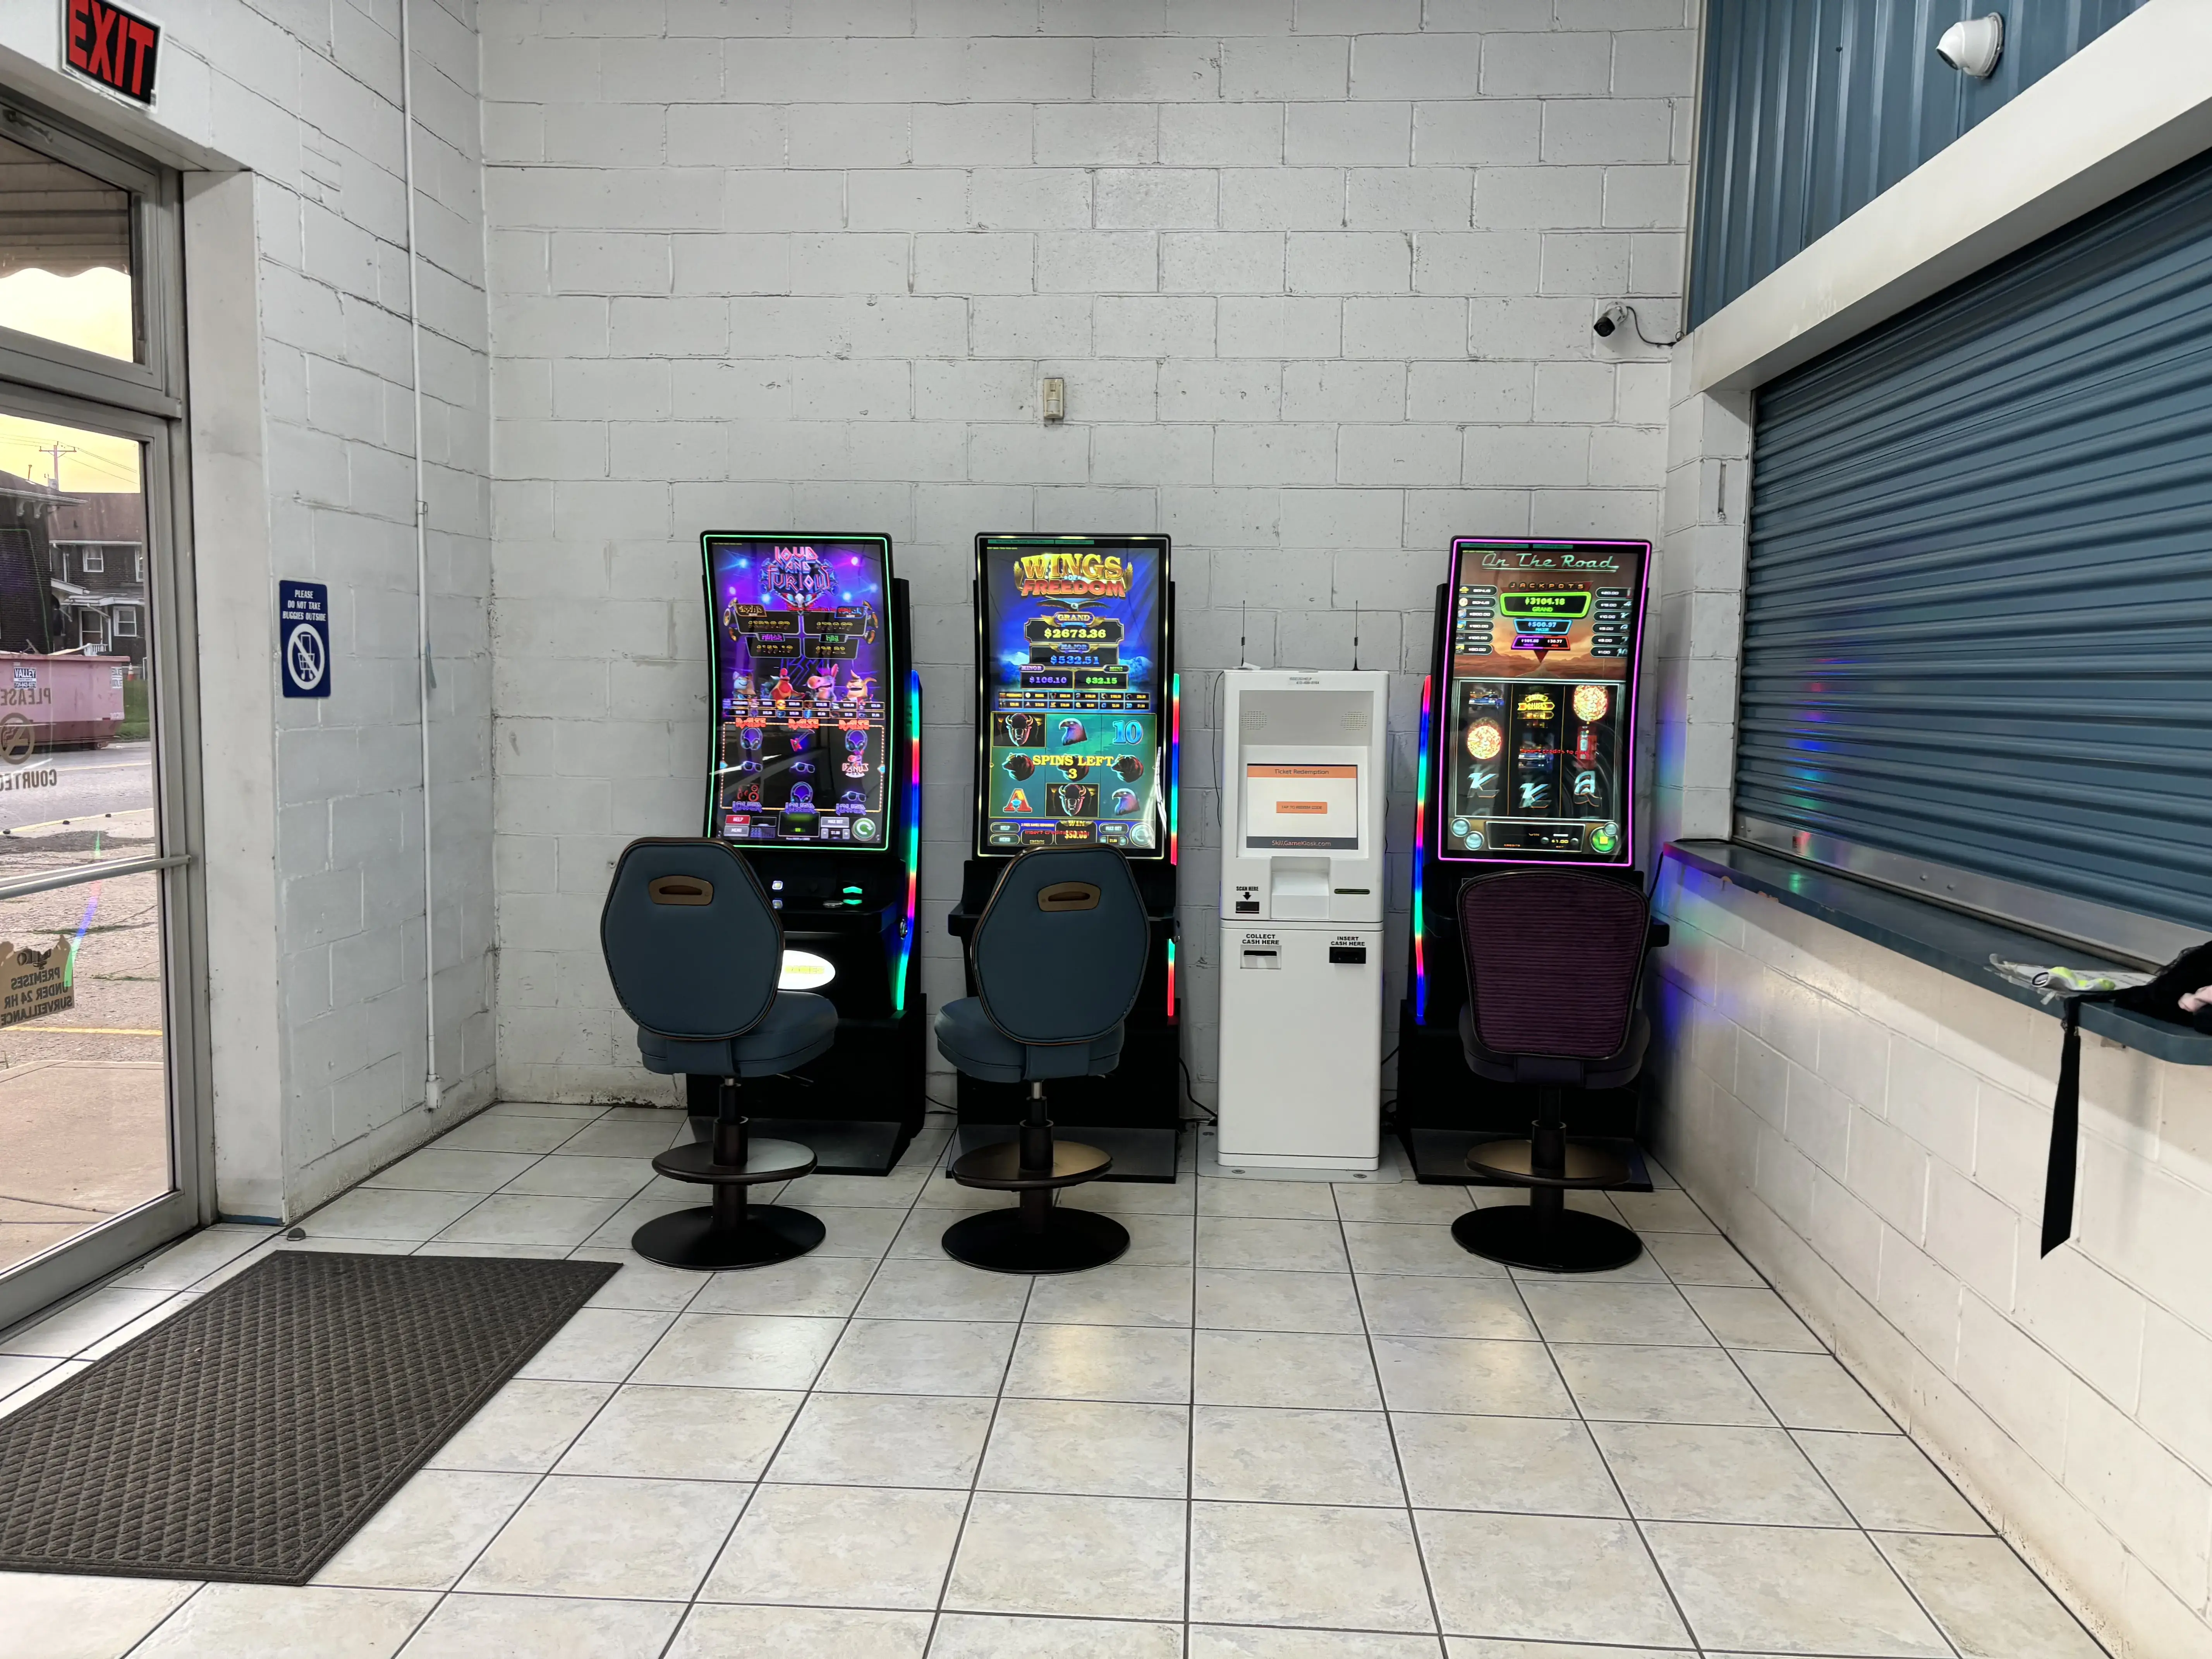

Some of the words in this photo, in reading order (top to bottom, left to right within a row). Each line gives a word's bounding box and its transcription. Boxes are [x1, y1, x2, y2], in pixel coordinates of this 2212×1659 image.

[69, 0, 155, 96] EXIT
[775, 546, 818, 565] LOUD
[1482, 553, 1510, 568] On
[1515, 553, 1557, 568] The
[1561, 554, 1619, 569] Road
[785, 561, 811, 571] AND
[1020, 553, 1123, 580] WINGS
[767, 565, 830, 593] FURIOUS
[295, 590, 314, 598] PLEASE
[1021, 579, 1126, 598] FREEDOM
[287, 600, 295, 608] DO
[297, 601, 307, 609] NOT
[308, 602, 321, 610] TAKE
[283, 611, 304, 620] BUGGIES
[306, 612, 326, 621] OUTSIDE
[1044, 628, 1106, 639] $2673.36
[1050, 654, 1100, 665] $532.51
[14, 669, 35, 678] VALLEY
[1029, 676, 1067, 685] $106.10
[1085, 676, 1118, 685] $32.15
[1112, 720, 1143, 745] 10
[1032, 754, 1073, 766] SPINS
[1077, 755, 1114, 767] LEFT
[1068, 768, 1077, 779] 3
[1003, 788, 1033, 813] A
